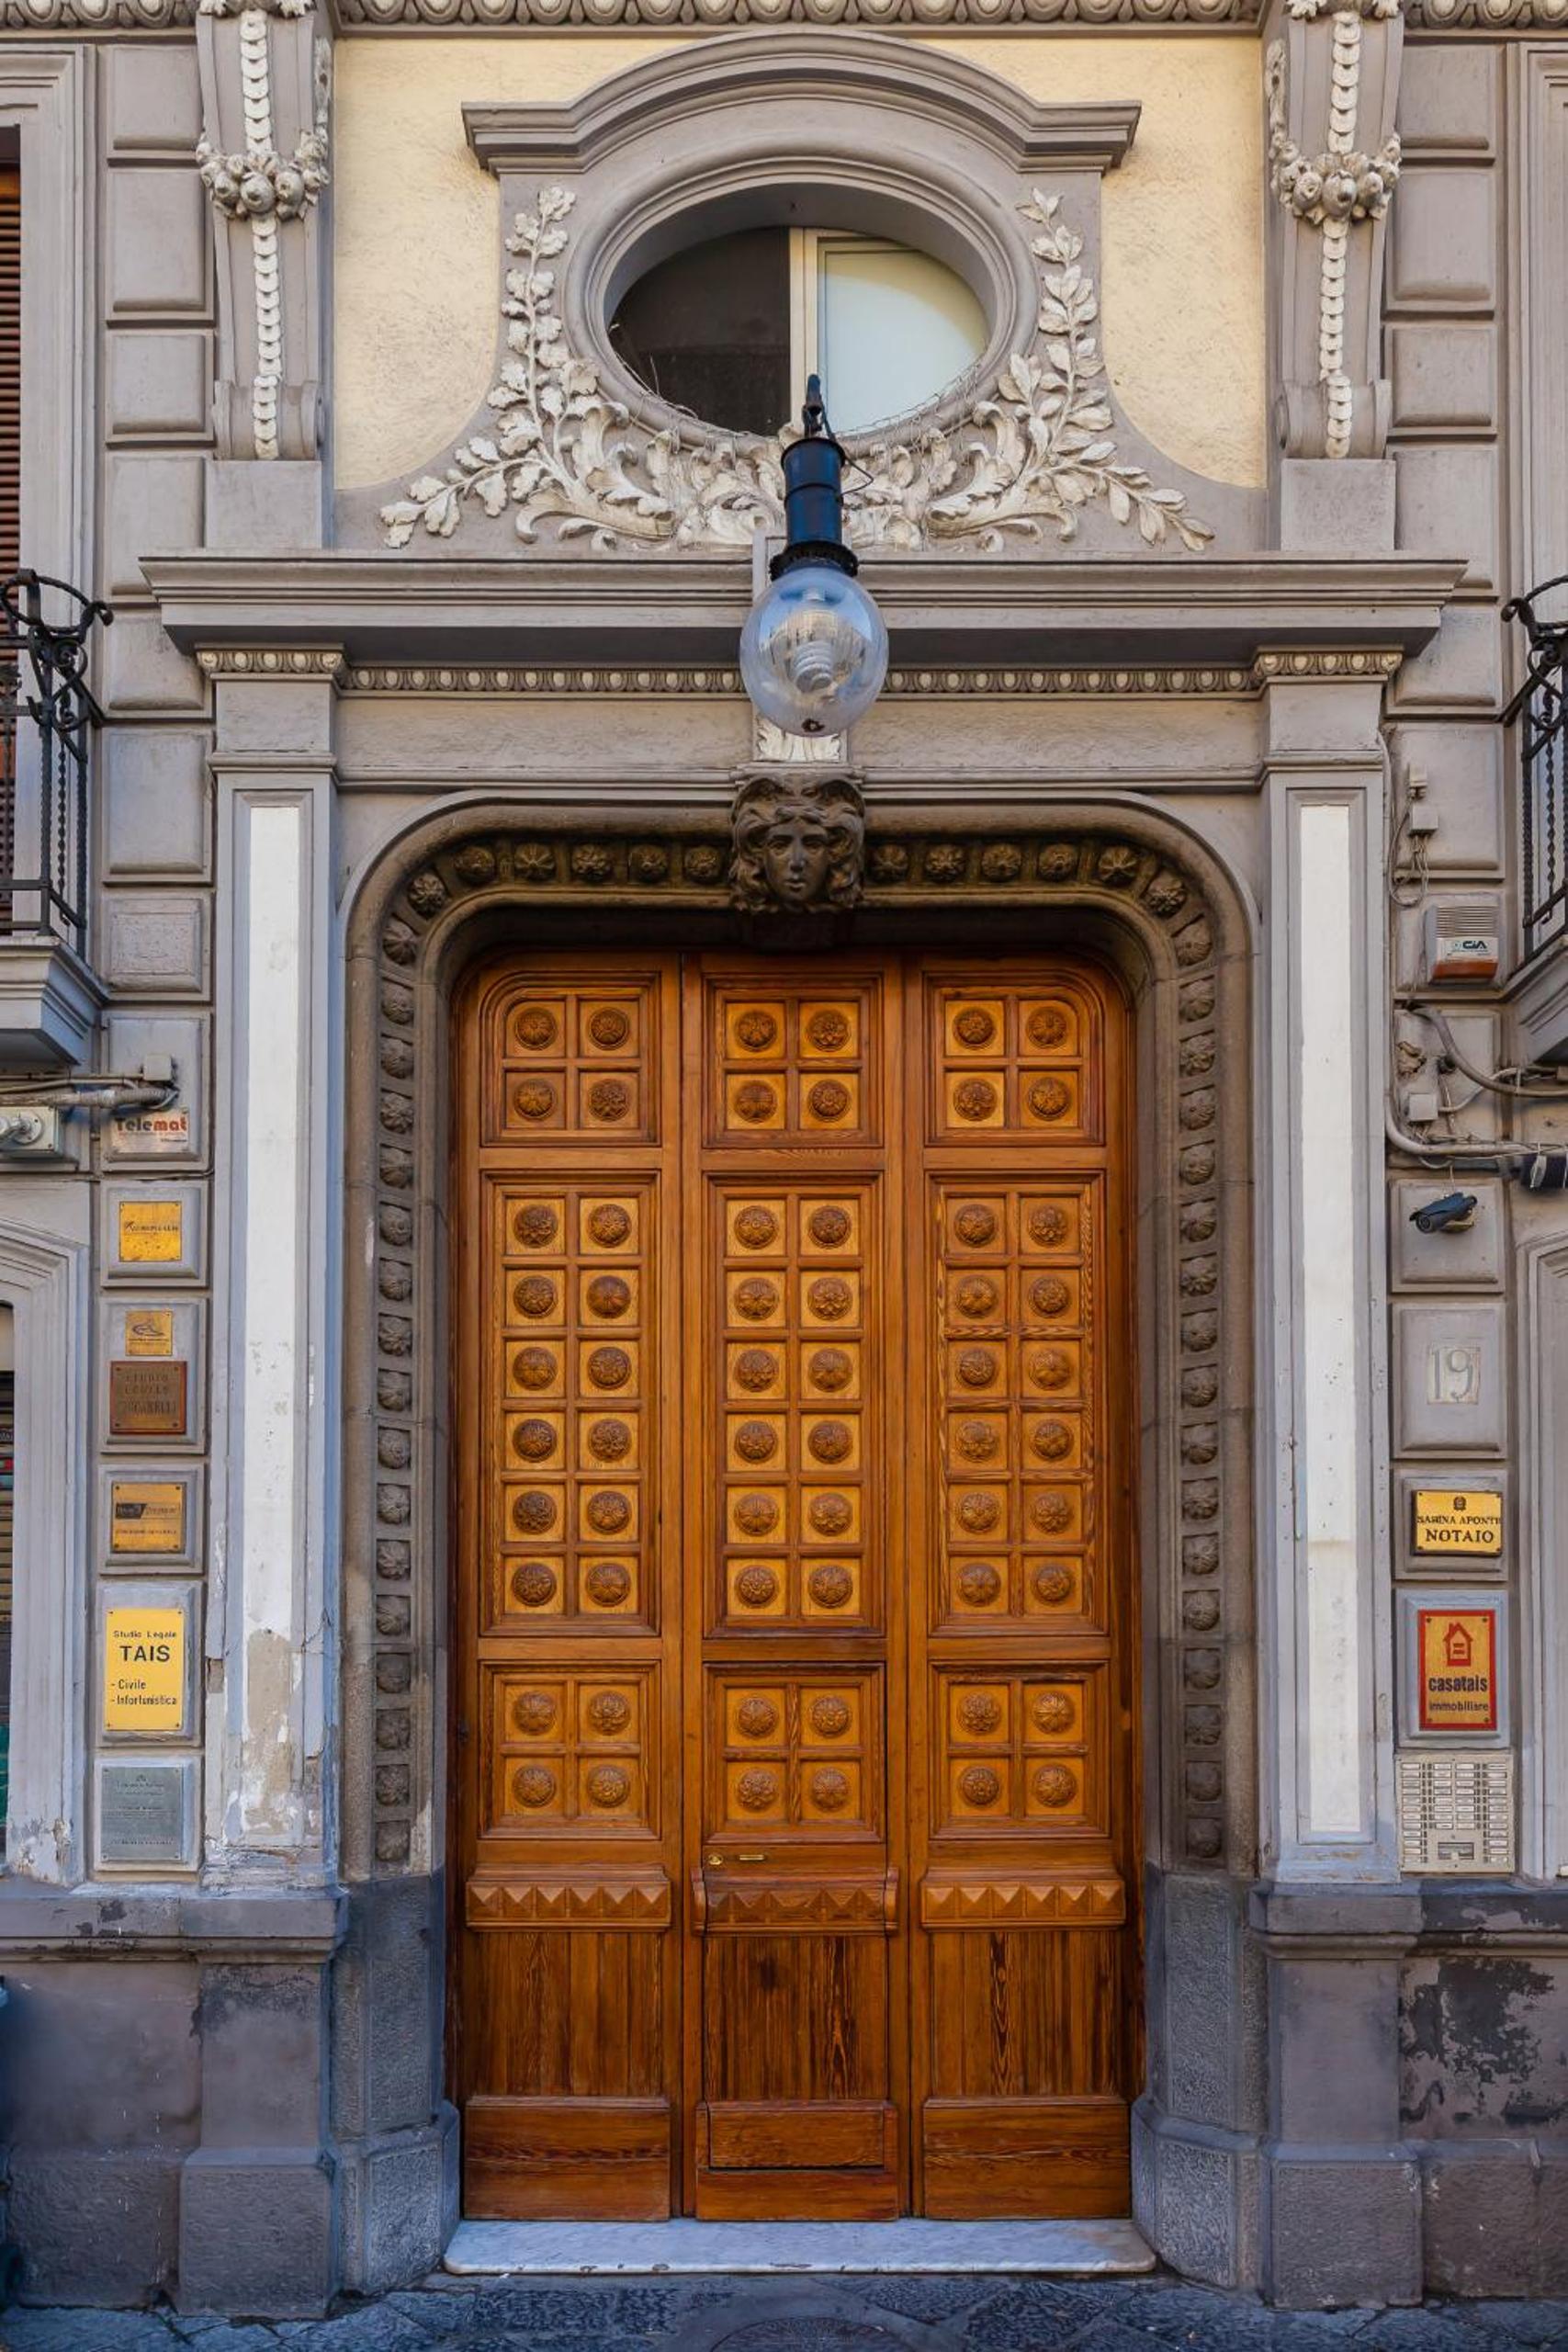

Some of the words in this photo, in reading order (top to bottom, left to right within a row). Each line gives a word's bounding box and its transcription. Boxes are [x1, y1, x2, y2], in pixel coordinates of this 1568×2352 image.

[115, 1116, 187, 1131] Telemat
[1432, 1349, 1473, 1399] 19
[1426, 1529, 1494, 1544] NOTAIO
[113, 1630, 141, 1638] Studio
[147, 1630, 176, 1639] Legale
[119, 1645, 170, 1662] TAIS
[118, 1679, 147, 1690] Civile
[1428, 1675, 1487, 1691] casatais
[1429, 1701, 1489, 1712] immobiliare
